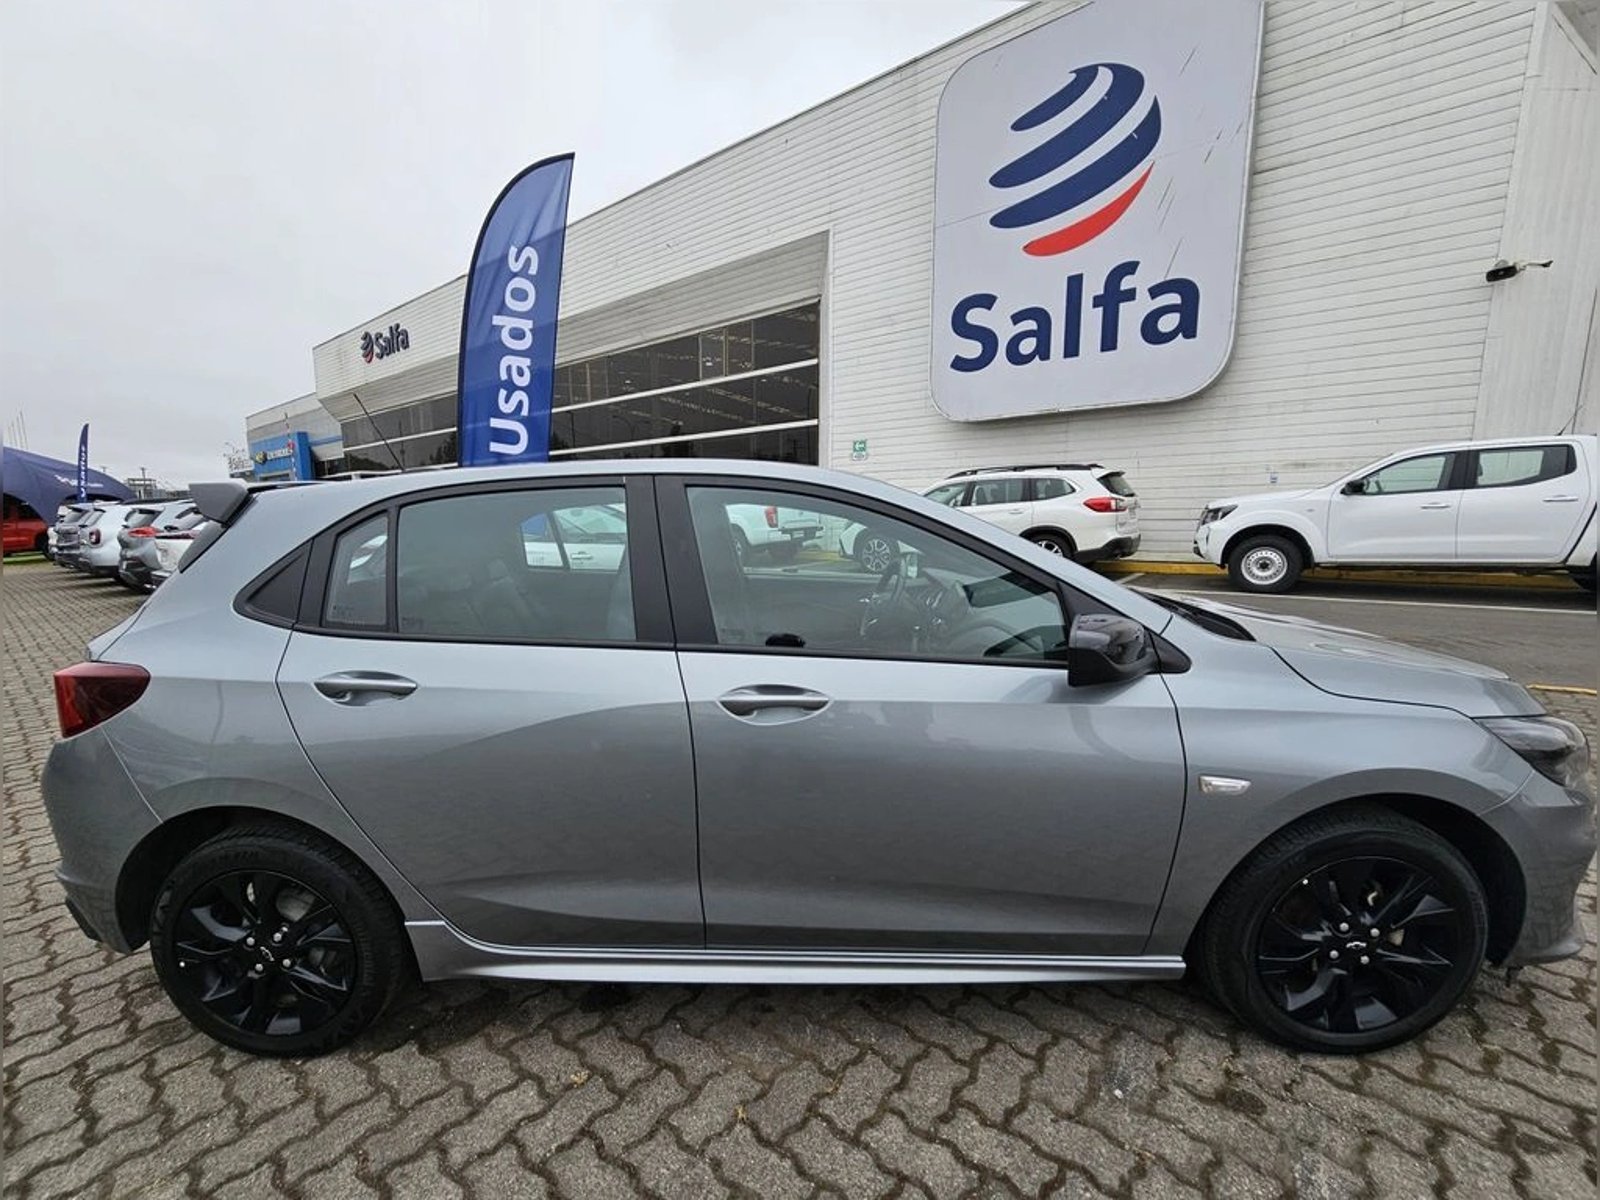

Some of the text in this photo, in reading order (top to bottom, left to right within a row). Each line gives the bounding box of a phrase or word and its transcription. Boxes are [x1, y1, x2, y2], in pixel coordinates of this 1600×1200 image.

[375, 323, 410, 360] Salfa
[489, 245, 539, 456] Usados
[950, 260, 1200, 372] Salfa
